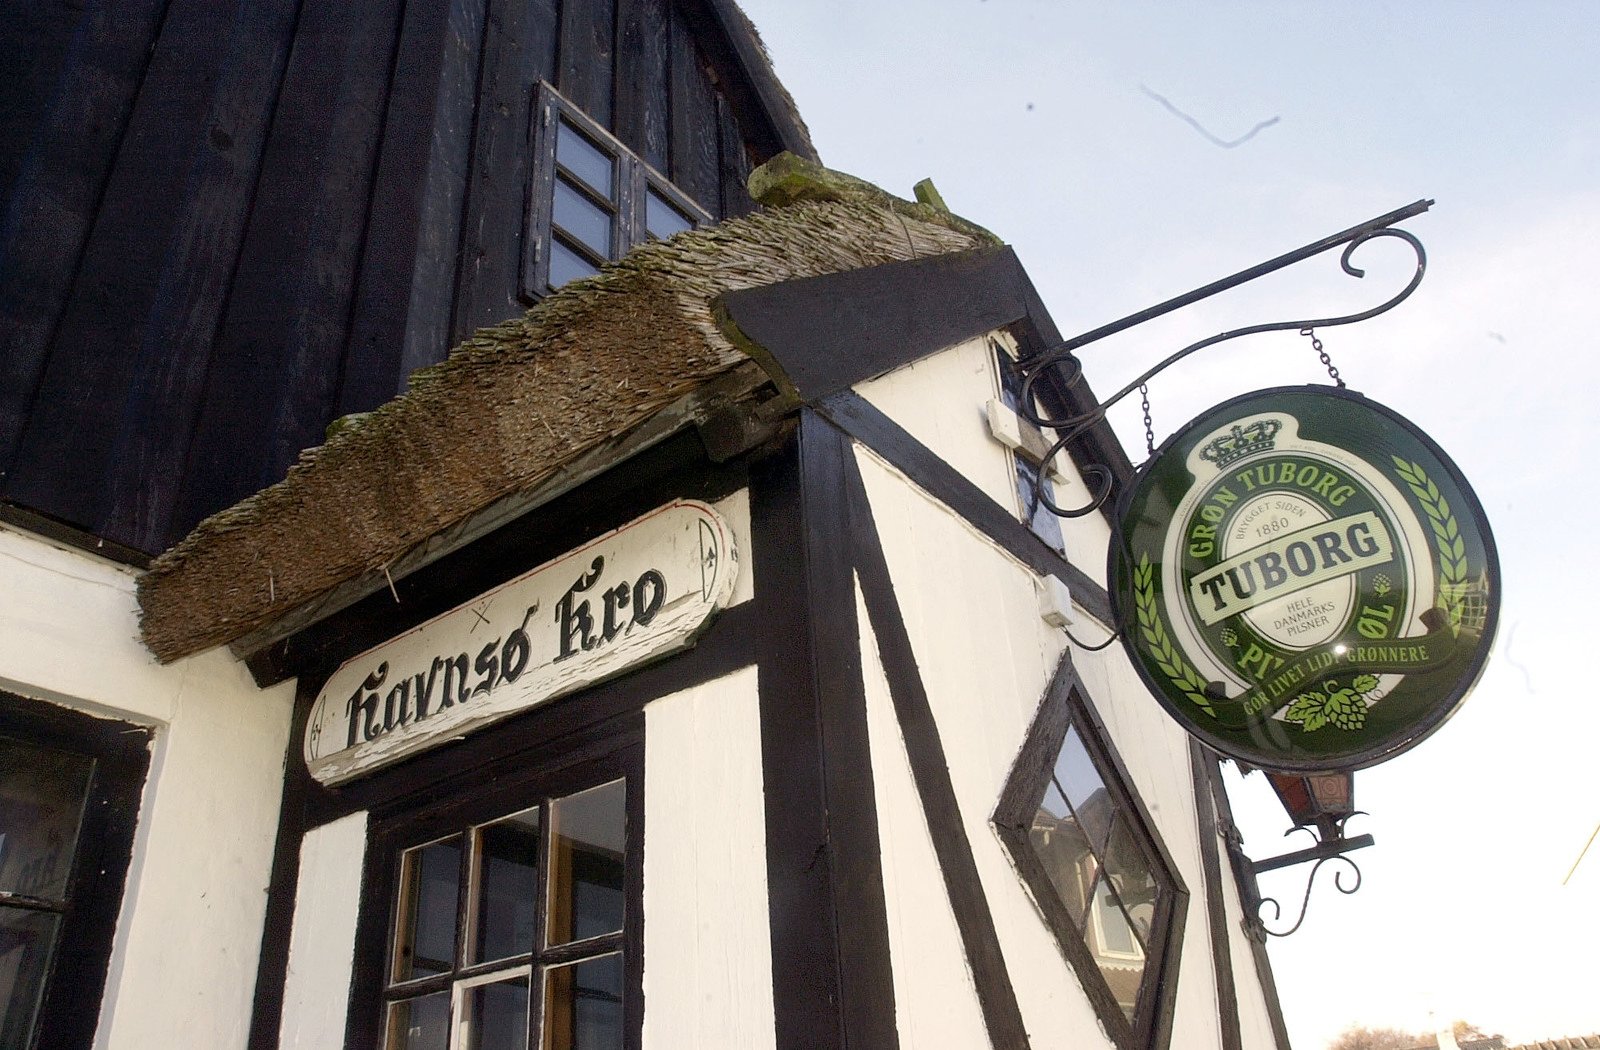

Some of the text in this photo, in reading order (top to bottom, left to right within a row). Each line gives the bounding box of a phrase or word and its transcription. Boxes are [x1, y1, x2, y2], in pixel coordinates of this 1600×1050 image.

[1189, 485, 1239, 559] GRØN
[1235, 462, 1356, 507] TUBORG
[1235, 500, 1307, 540] BRYGGET SIDEN
[1255, 517, 1290, 538] 1880
[1199, 521, 1380, 612] TUBORG
[1273, 601, 1335, 630] DANMARKS
[1286, 596, 1313, 613] HELE
[1356, 604, 1395, 640] ØL
[1286, 615, 1330, 637] PILSNER
[1267, 663, 1306, 697] LIVET
[1347, 645, 1430, 663] GRØNNERE
